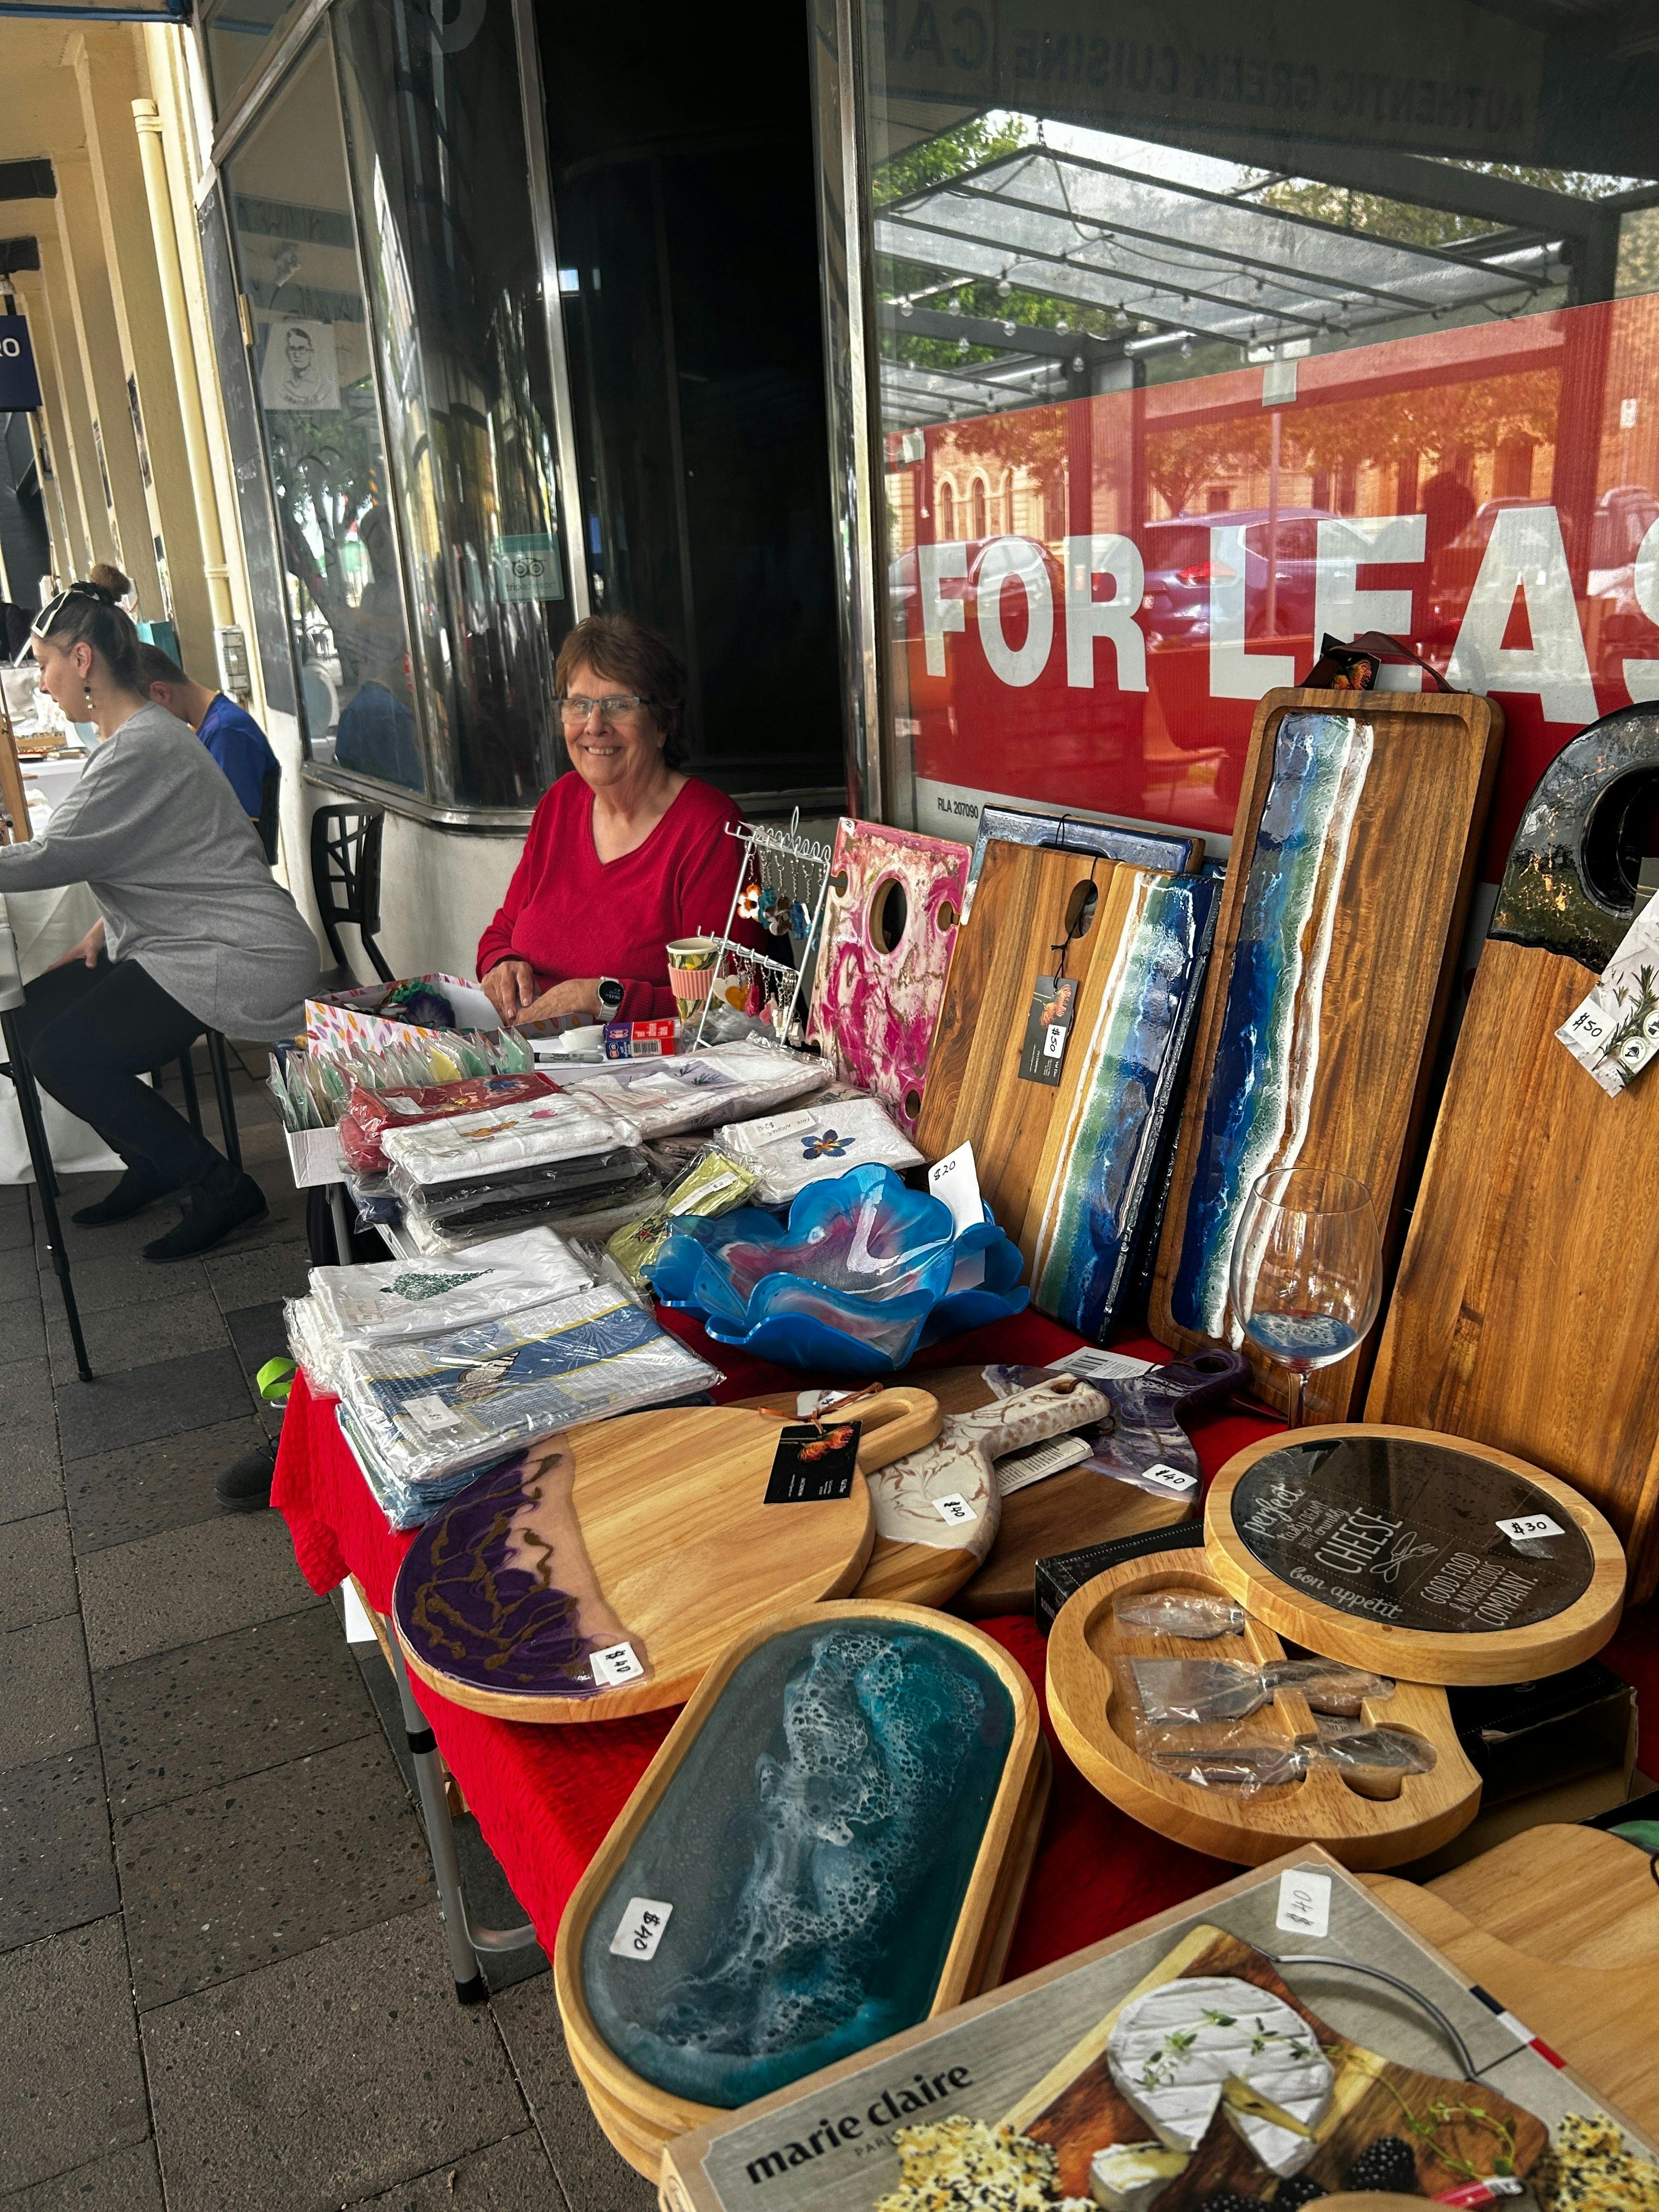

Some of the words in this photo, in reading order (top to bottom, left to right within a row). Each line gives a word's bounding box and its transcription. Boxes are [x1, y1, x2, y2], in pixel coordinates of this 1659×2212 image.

[917, 533, 1149, 692] FOR
[938, 798, 952, 814] RLA
[954, 802, 979, 819] 207090
[1050, 1026, 1060, 1052] $50
[1572, 1012, 1602, 1037] $50
[933, 1161, 956, 1181] $20
[1155, 1468, 1186, 1485] $40
[943, 1501, 966, 1517] $40
[1242, 1482, 1306, 1539] perfect
[1314, 1506, 1403, 1574] CHEESE
[1511, 1521, 1547, 1534] $30
[1289, 1566, 1327, 1589] bon
[1420, 1575, 1460, 1605] GOOD
[1440, 1552, 1480, 1580] FOOD
[1453, 1560, 1506, 1607] MARVELOUS
[1449, 1602, 1472, 1613] &
[1474, 1571, 1539, 1626] COMPANY.
[1285, 1890, 1314, 1926] $40
[634, 1910, 661, 1950] $40
[746, 2115, 864, 2185] marie
[867, 2065, 973, 2127] claire
